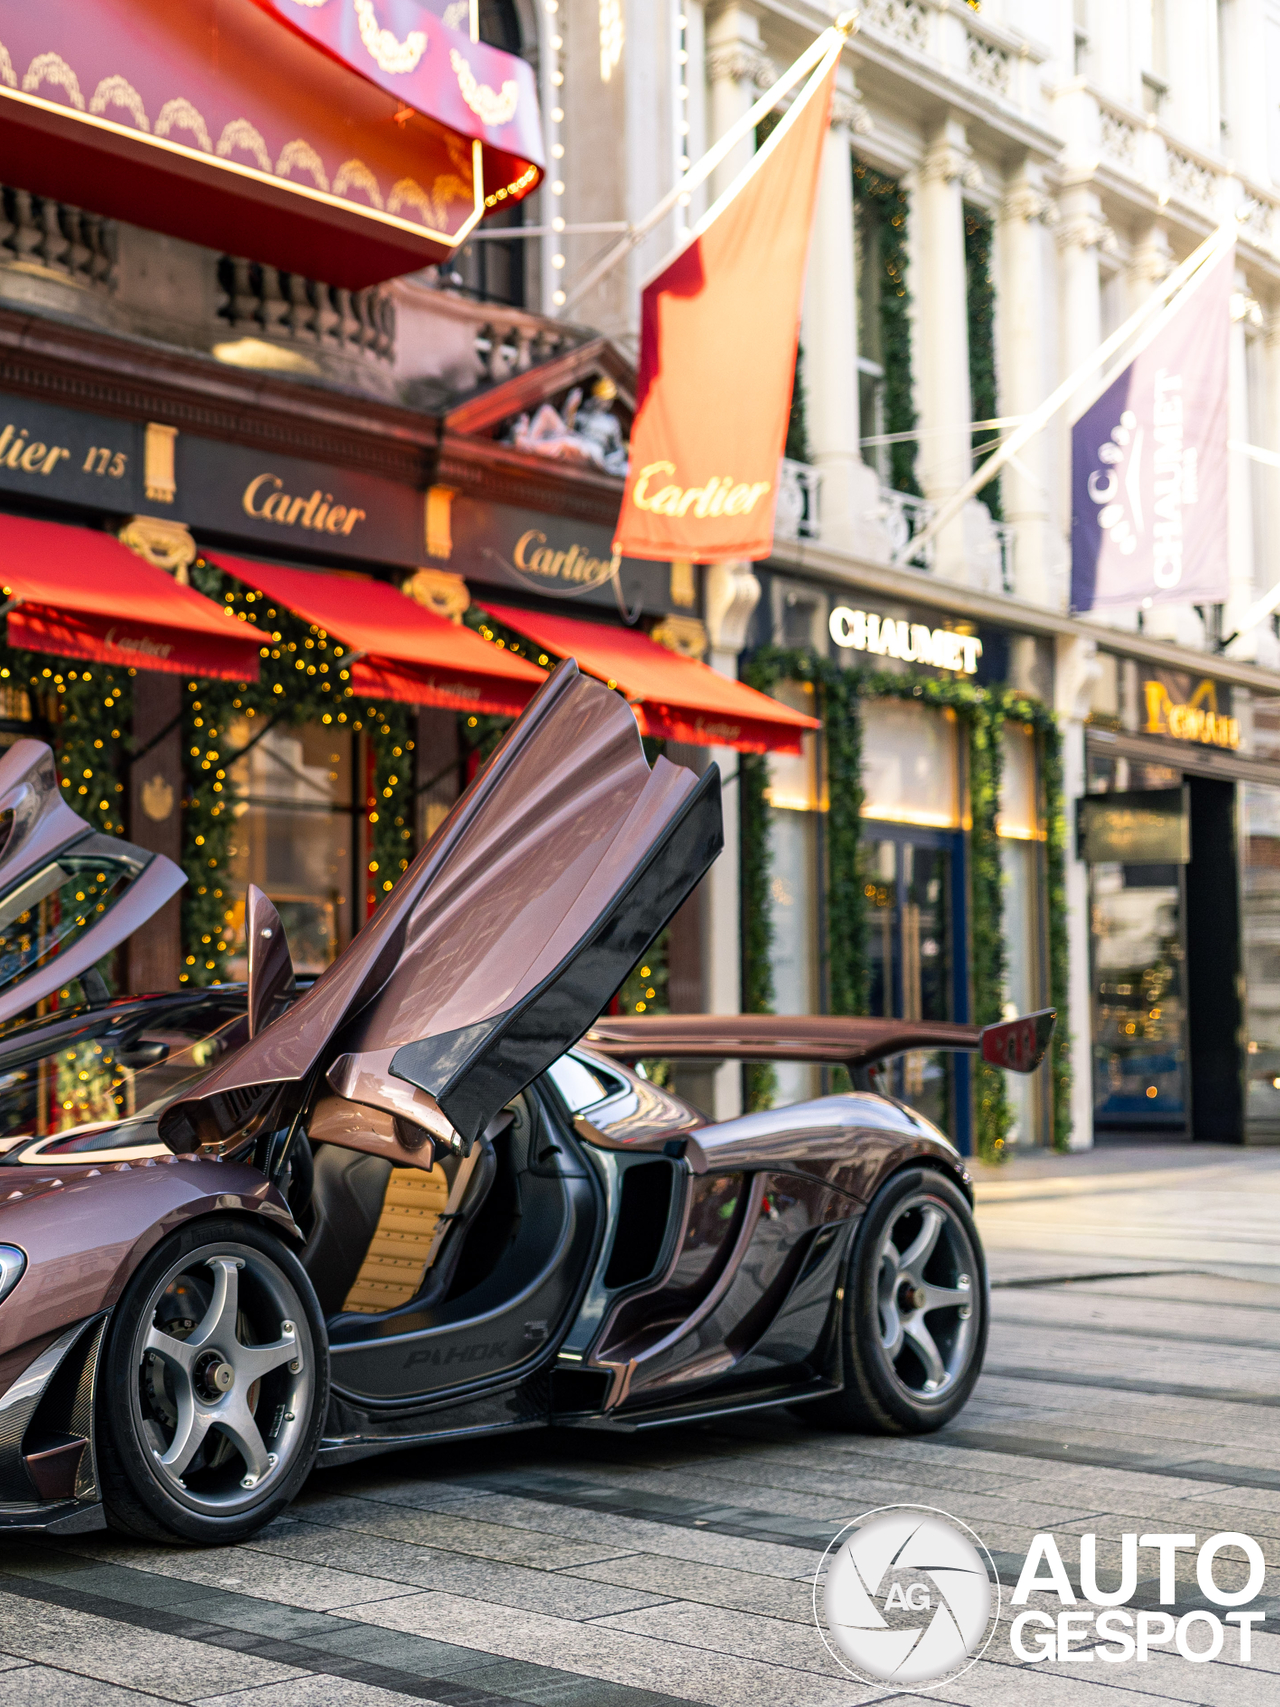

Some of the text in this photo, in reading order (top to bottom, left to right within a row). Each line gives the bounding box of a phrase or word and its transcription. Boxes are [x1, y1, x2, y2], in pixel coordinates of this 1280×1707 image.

[82, 446, 128, 477] 175
[633, 460, 771, 518] Cartier
[1153, 367, 1183, 589] CHAUMET
[243, 473, 366, 536] Cartier
[829, 606, 983, 674] CHAUMET
